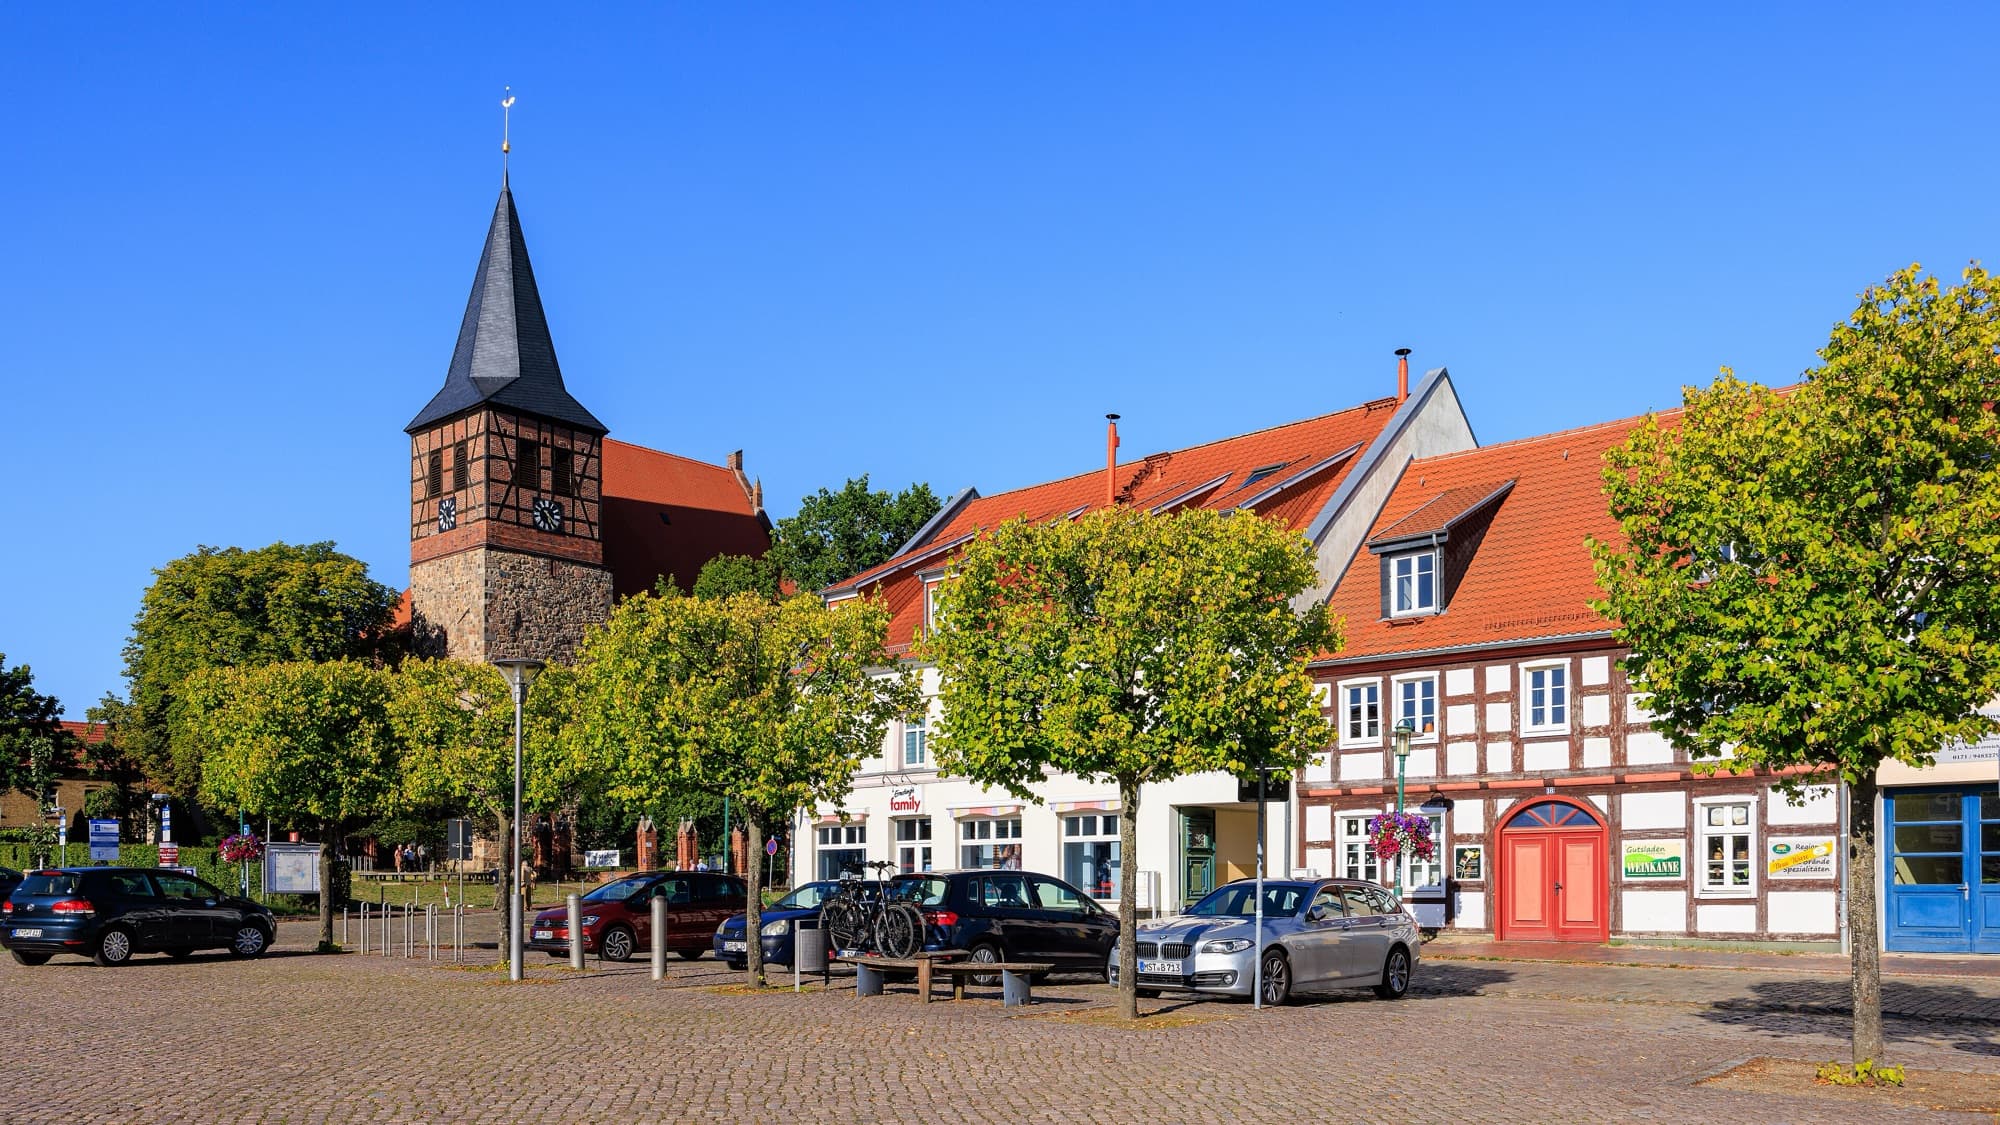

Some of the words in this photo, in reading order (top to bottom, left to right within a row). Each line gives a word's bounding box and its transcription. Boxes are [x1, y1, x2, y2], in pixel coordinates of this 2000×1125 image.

[890, 795, 921, 813] family
[1626, 845, 1666, 854] Gutsladen
[1627, 861, 1679, 873] WEINKANNE
